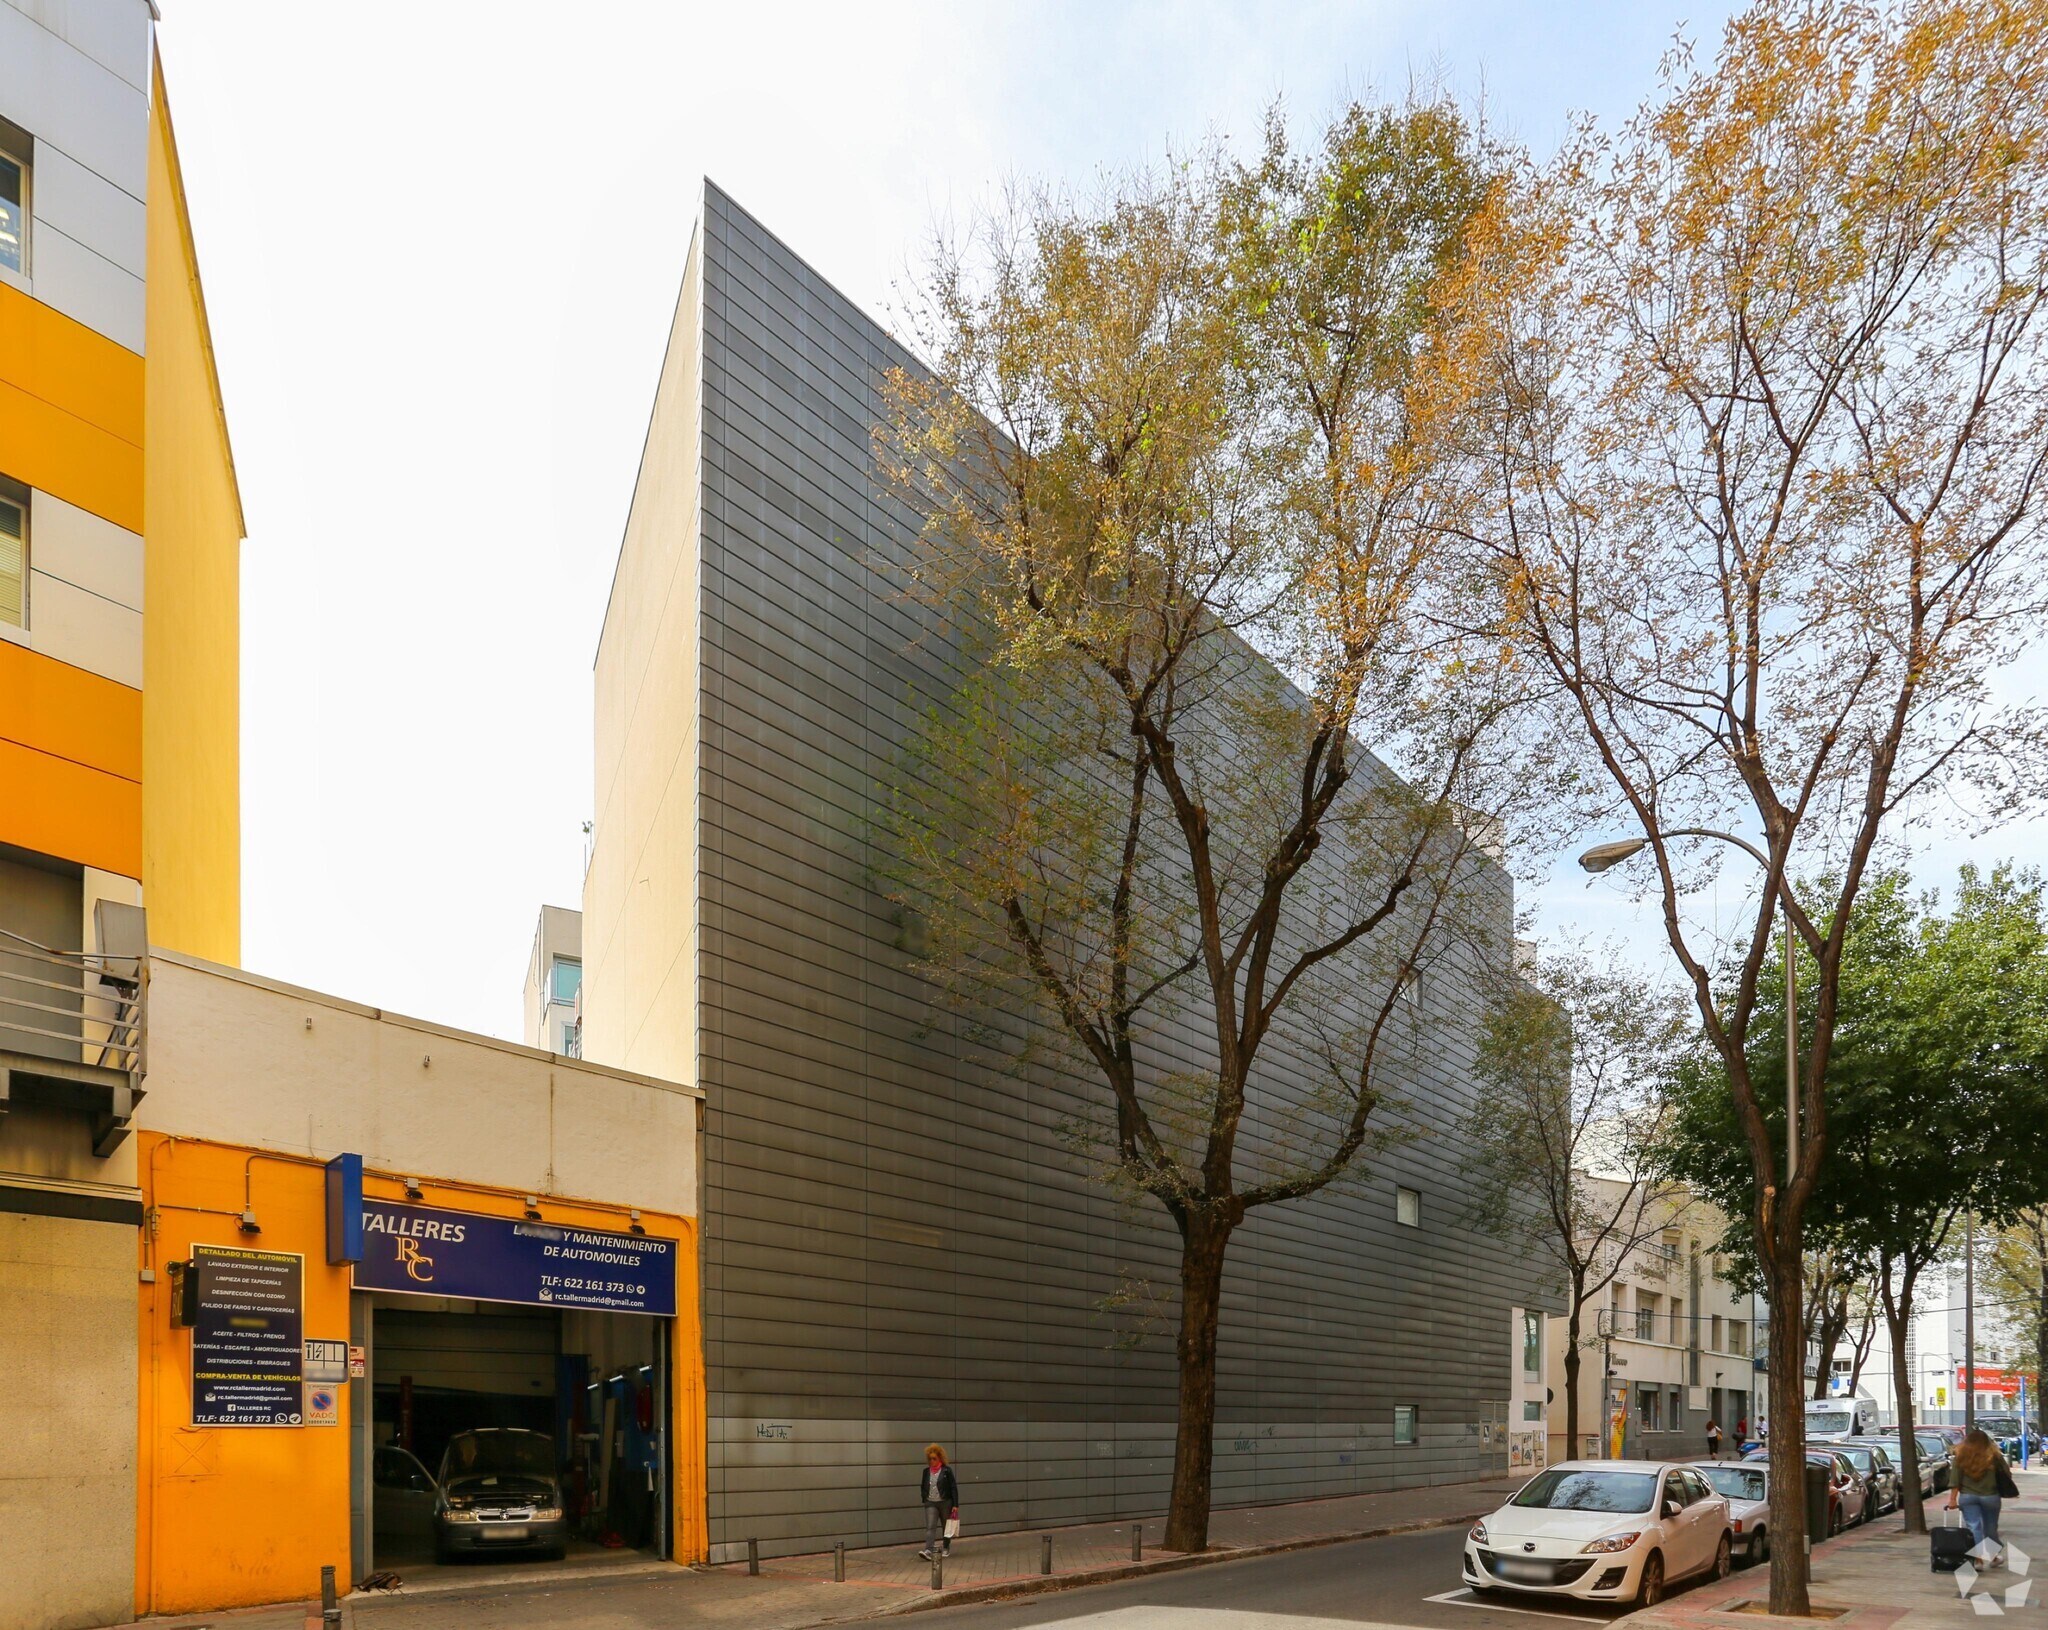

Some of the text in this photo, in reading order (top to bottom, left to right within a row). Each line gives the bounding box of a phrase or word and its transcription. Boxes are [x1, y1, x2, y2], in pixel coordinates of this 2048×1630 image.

[362, 1212, 466, 1243] TALLERES
[563, 1232, 572, 1242] Y
[572, 1232, 667, 1254] MANTENIMIENTO
[199, 1247, 298, 1263] DETALLADO DEL AUTOMÓVIL
[543, 1246, 641, 1266] DE AUTOMOVILES
[207, 1261, 231, 1269] LAVADO
[231, 1263, 259, 1271] EXTERIOR
[215, 1275, 241, 1283] LIMPIEZA
[541, 1275, 624, 1293] TLF: 622 161 373
[555, 1293, 645, 1308] rc.tallermadrid@gmail.com
[195, 1372, 251, 1380] COMPRA-VENTA
[196, 1415, 271, 1423] TLF: 622 161 373
